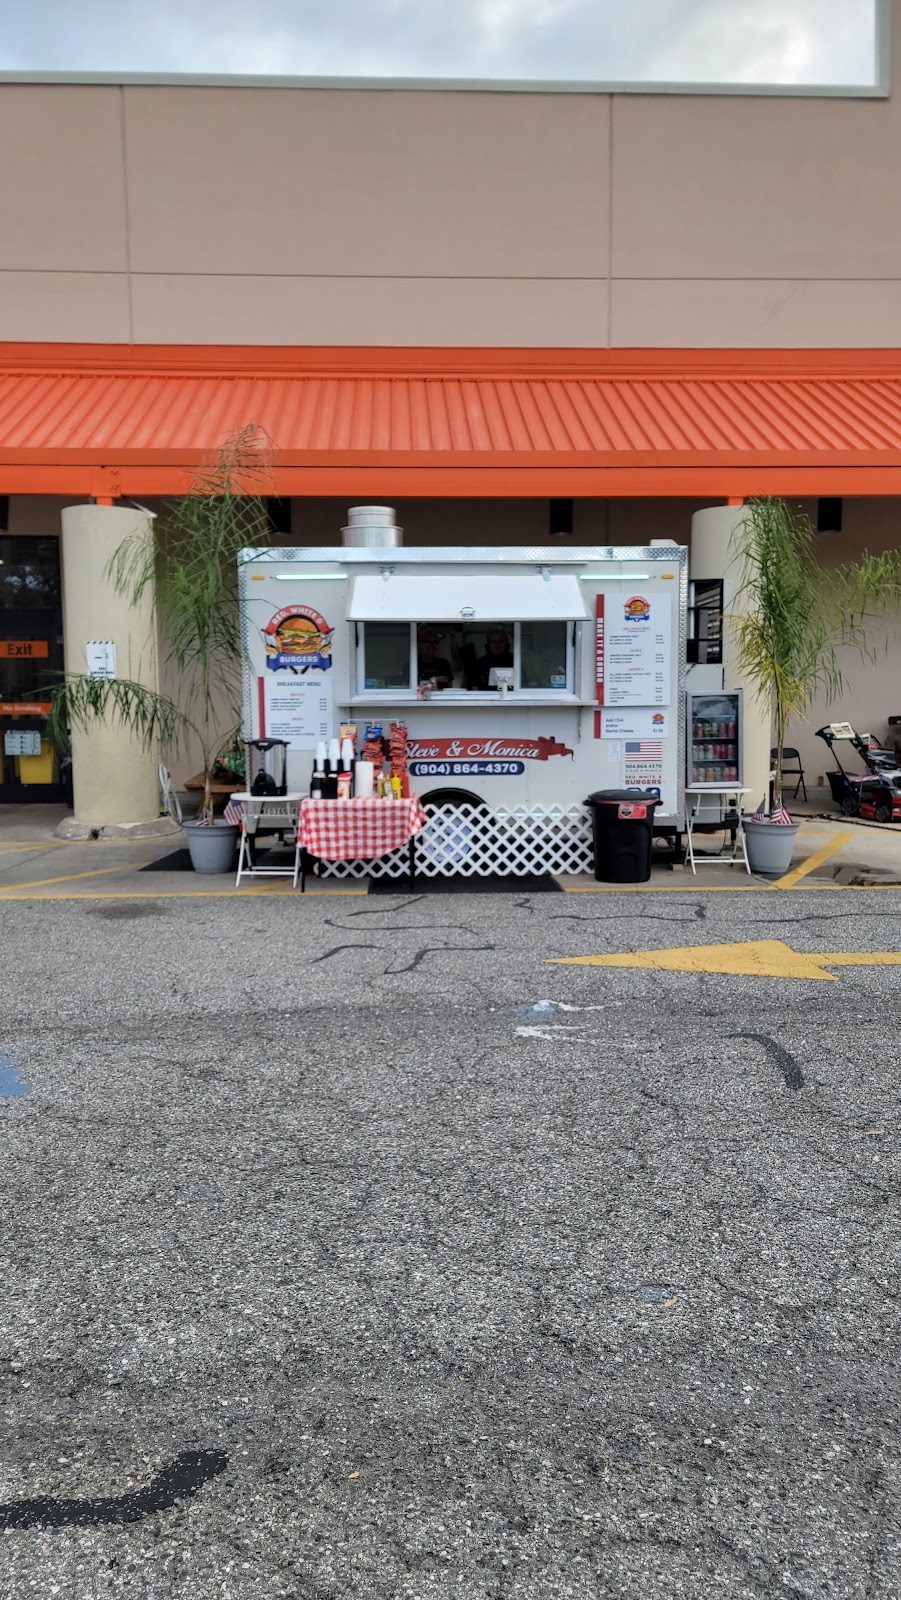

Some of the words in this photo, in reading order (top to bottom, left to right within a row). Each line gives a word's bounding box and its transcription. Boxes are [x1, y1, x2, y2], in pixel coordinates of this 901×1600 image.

[290, 607, 317, 619] WHITE
[596, 617, 604, 637] MAKE
[7, 643, 33, 655] Exit
[596, 656, 604, 683] COMBO
[406, 741, 440, 757] Steve
[445, 740, 464, 757] &
[466, 740, 540, 758] Monica
[415, 763, 450, 775] (904)
[453, 763, 518, 774] 864-4370
